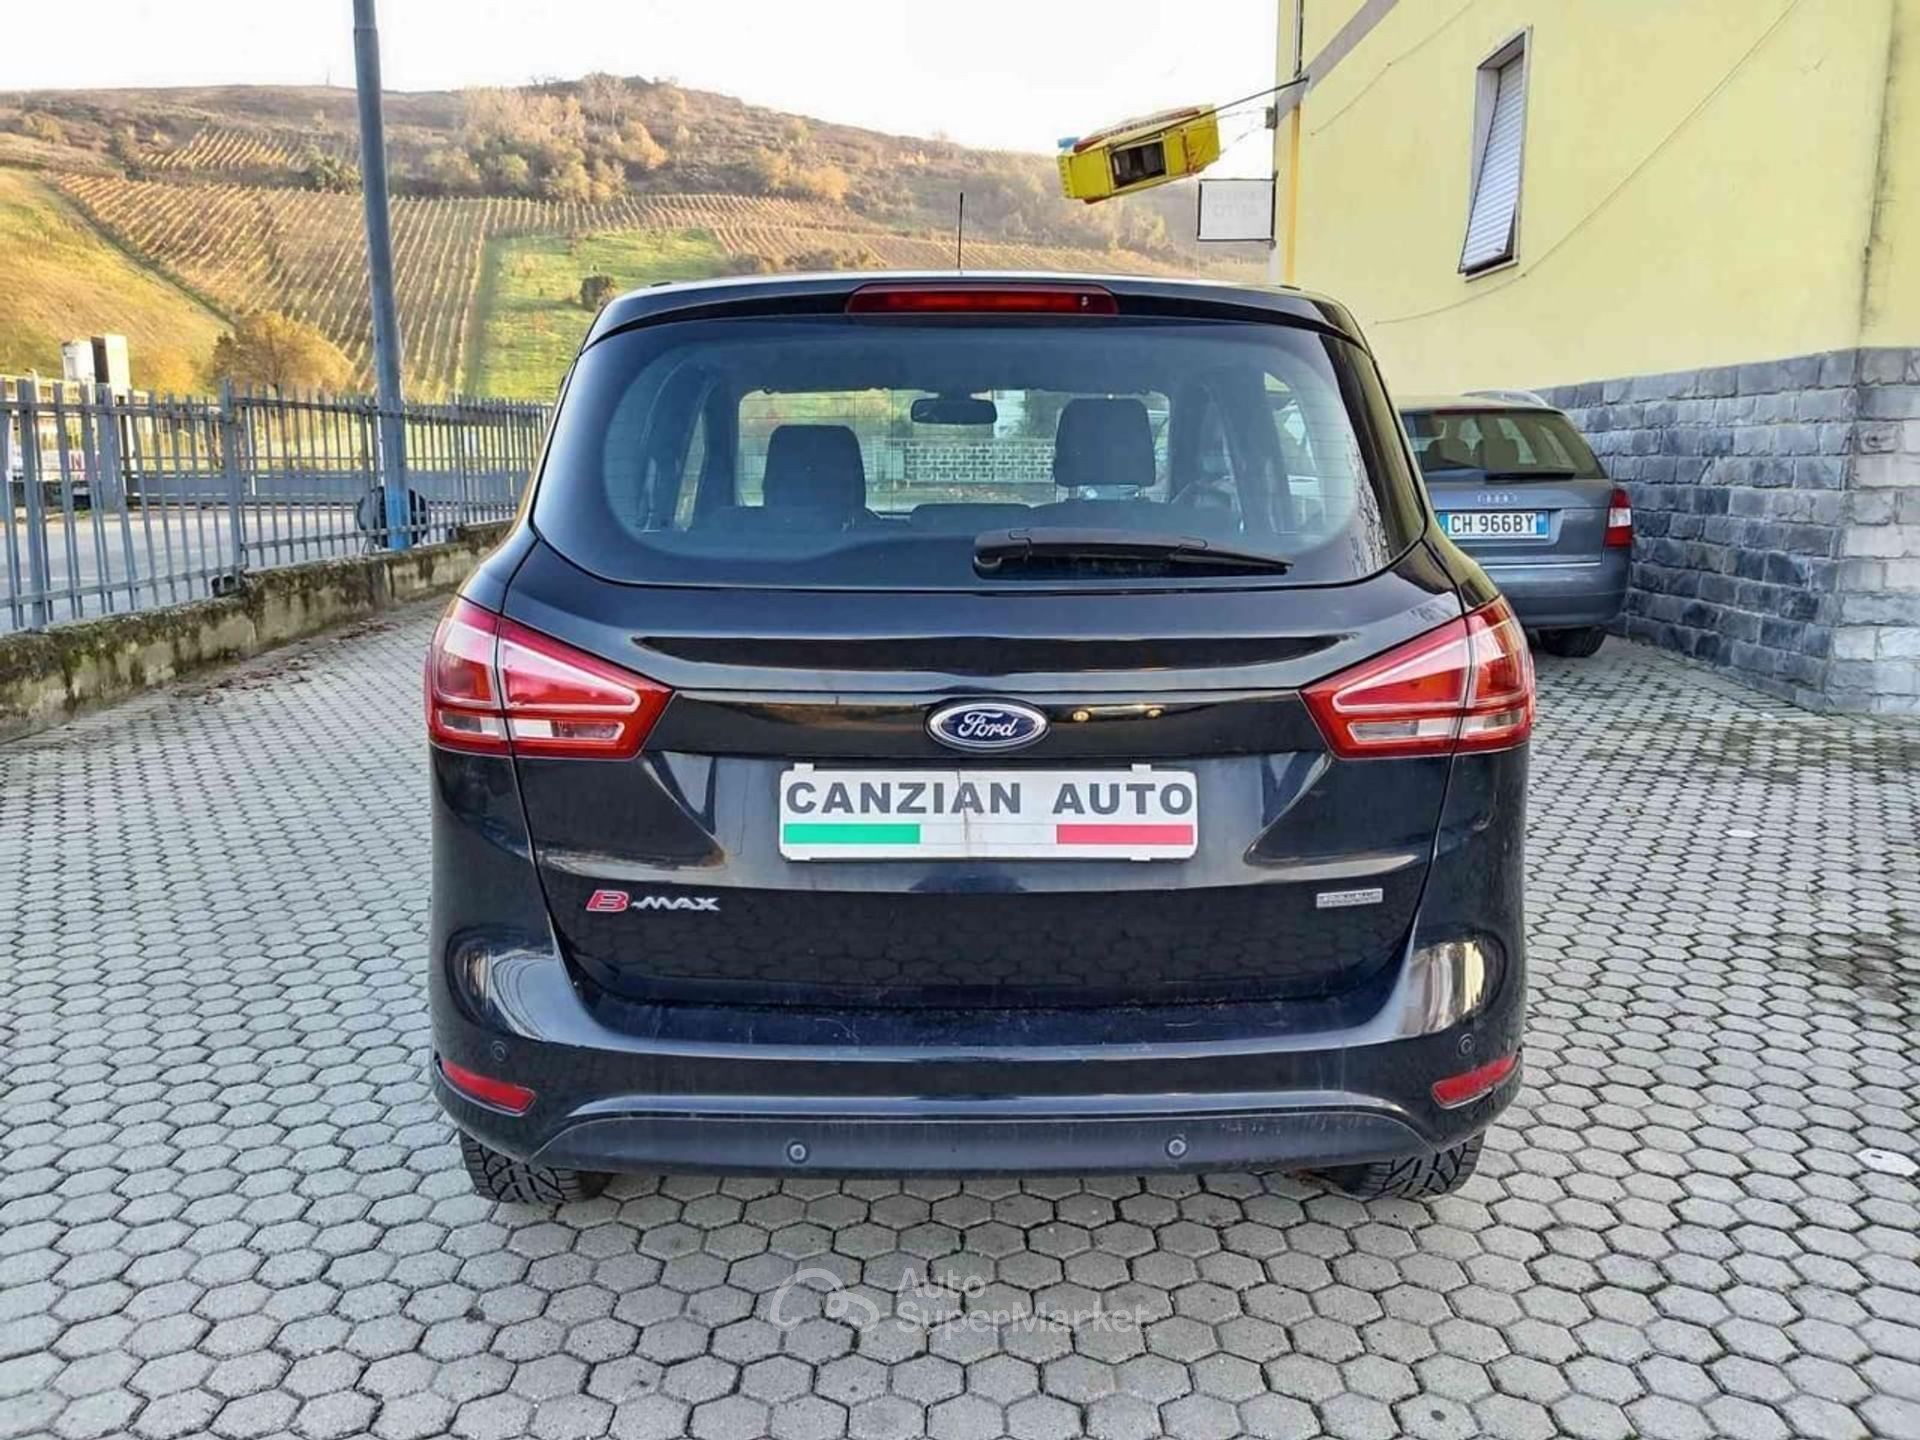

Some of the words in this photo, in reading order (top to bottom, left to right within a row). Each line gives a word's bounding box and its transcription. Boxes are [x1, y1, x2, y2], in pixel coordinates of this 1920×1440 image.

[1452, 516, 1472, 532] CH
[1480, 515, 1534, 532] 966BY
[958, 711, 1018, 738] Ford
[786, 782, 1021, 814] CANZIAN
[1052, 782, 1193, 815] AUTO
